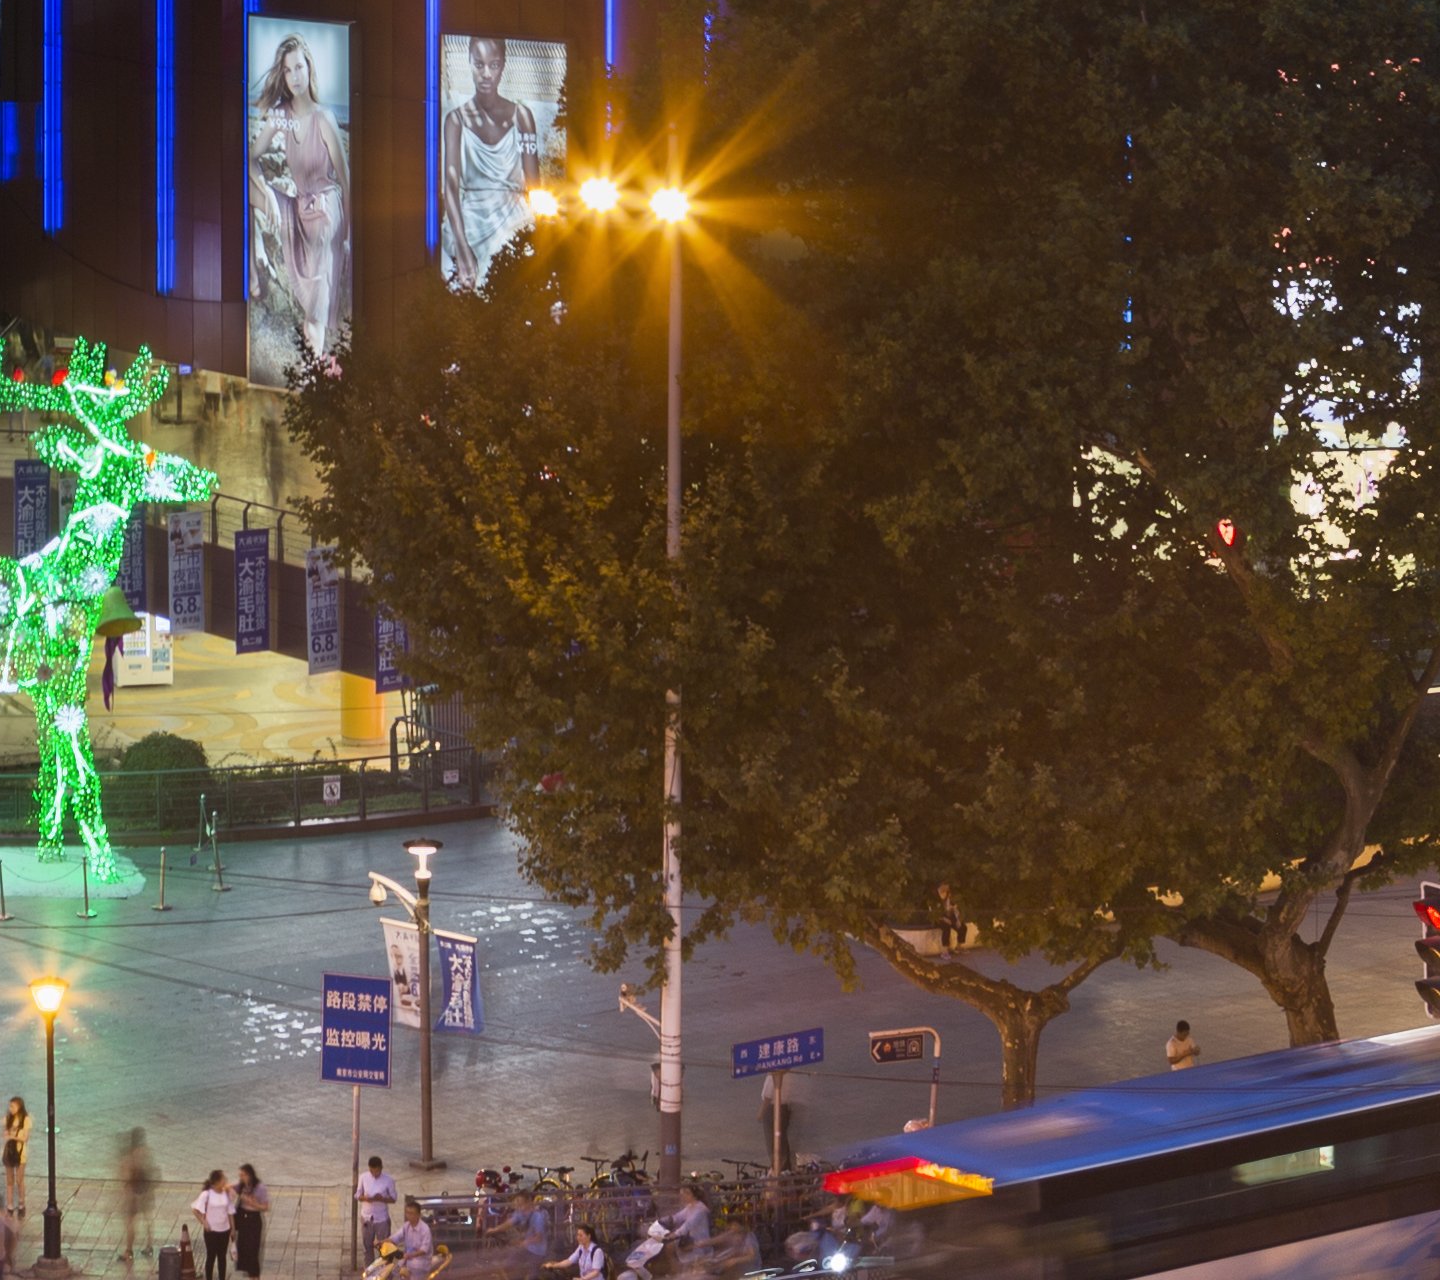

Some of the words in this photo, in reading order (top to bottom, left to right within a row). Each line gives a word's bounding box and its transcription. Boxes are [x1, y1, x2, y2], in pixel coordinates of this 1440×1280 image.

[238, 558, 255, 634] 大渝毛肚
[326, 990, 388, 1014] 路段禁停
[325, 1028, 387, 1052] 监控曝光
[758, 1037, 800, 1060] 建康路
